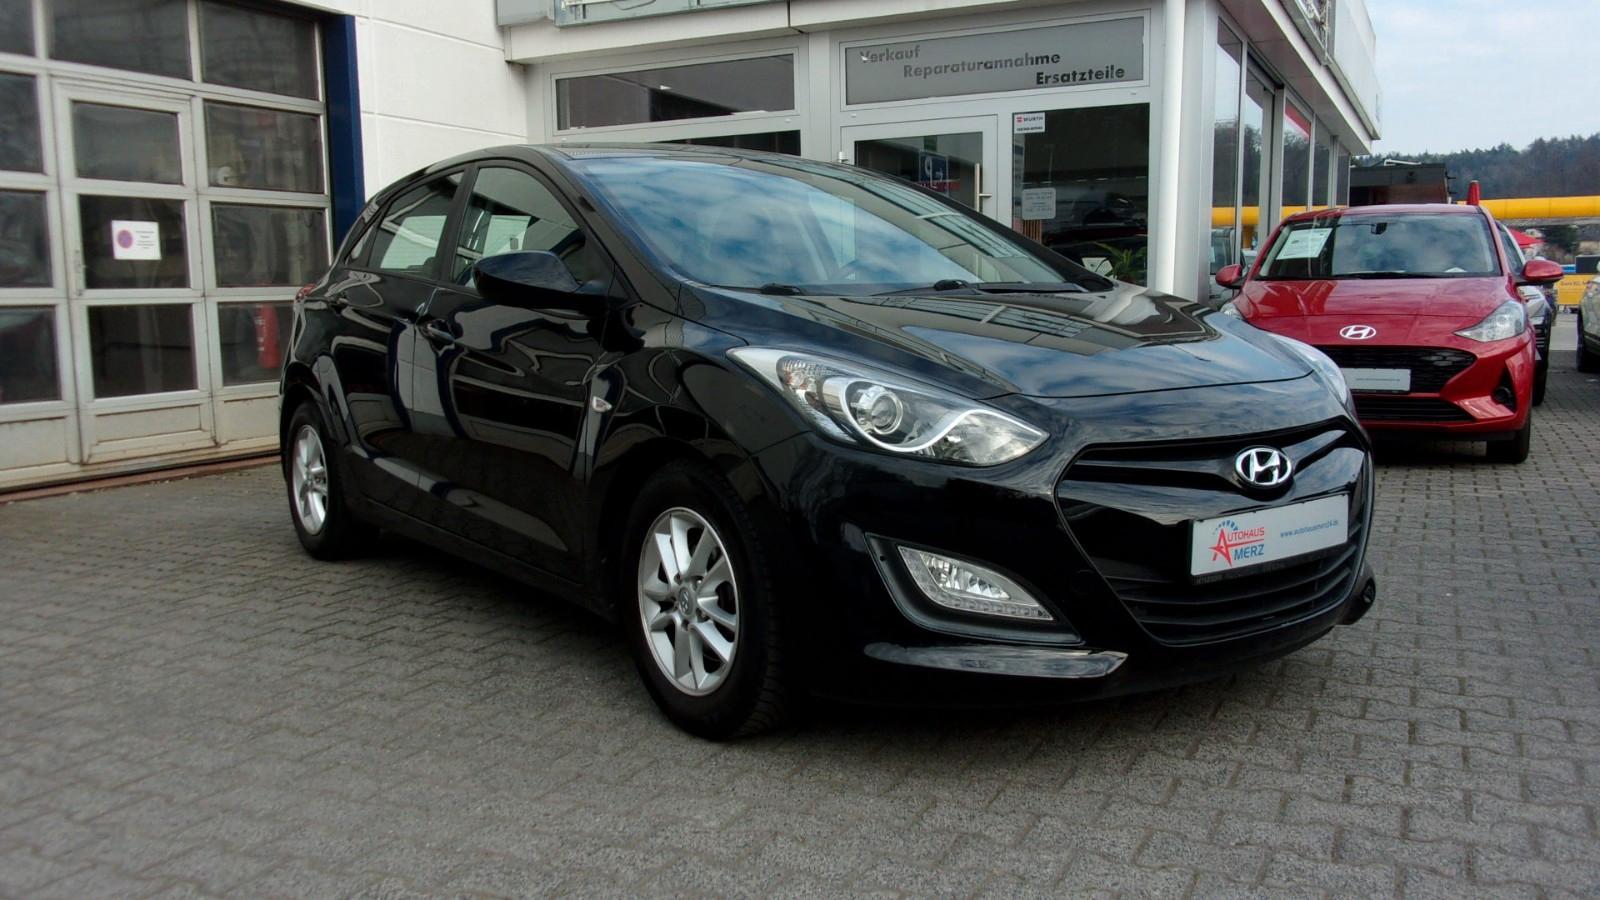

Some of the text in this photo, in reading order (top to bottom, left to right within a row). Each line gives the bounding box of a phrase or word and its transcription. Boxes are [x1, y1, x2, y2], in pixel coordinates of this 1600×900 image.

[860, 45, 920, 63] Verkauf
[903, 53, 1061, 79] Reparaturannahme
[1036, 65, 1125, 85] Ersatzteile
[1208, 527, 1265, 568] AUTOHAUS
[1233, 543, 1265, 560] MERZ
